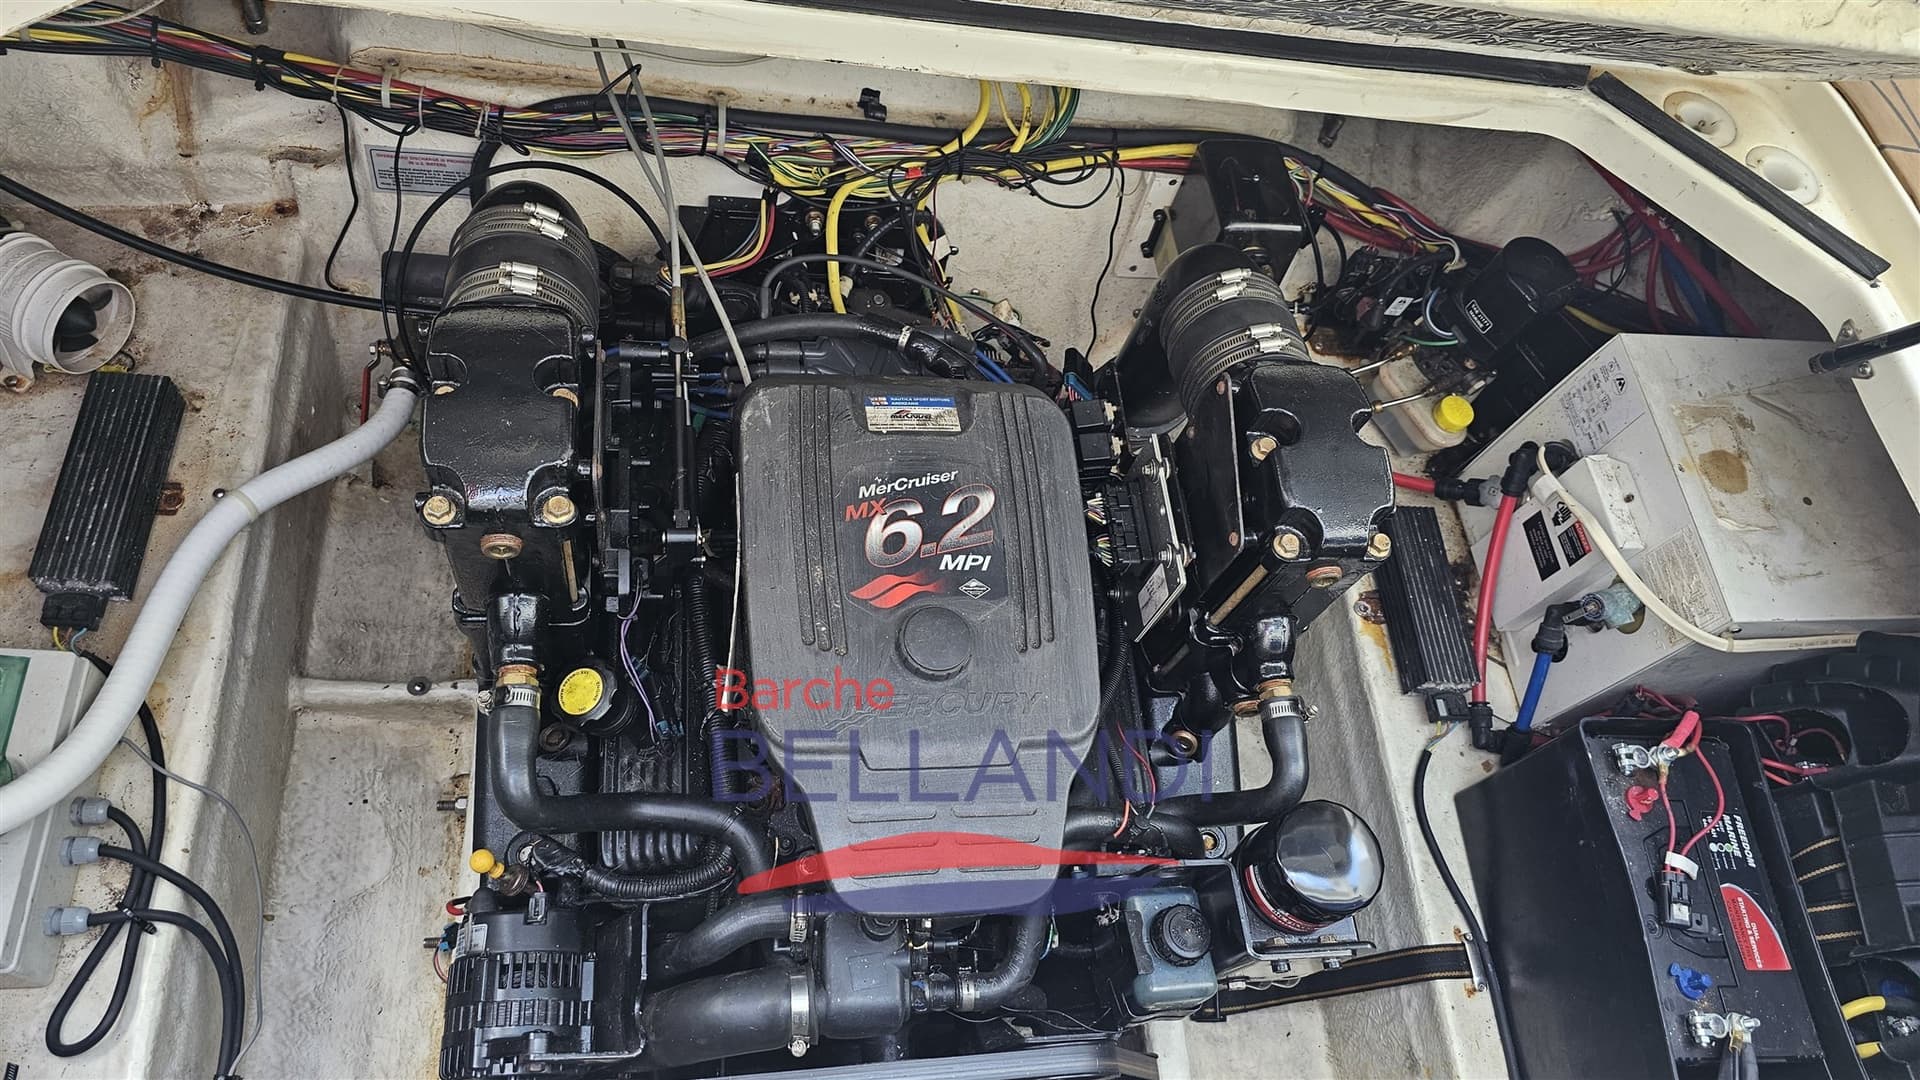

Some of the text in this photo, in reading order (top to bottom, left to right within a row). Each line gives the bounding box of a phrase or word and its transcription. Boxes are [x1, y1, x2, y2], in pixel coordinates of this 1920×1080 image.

[859, 470, 958, 499] MerCruiser
[845, 498, 887, 521] MX
[865, 483, 995, 568] 6.2
[939, 554, 991, 571] MPI
[842, 691, 1043, 718] MERCURY
[1722, 814, 1742, 858] MARINE
[1733, 814, 1756, 867] FREEDOM
[1737, 896, 1751, 929] STARTING
[1749, 935, 1763, 968] SERVICES
[1750, 922, 1760, 940] DUAL
